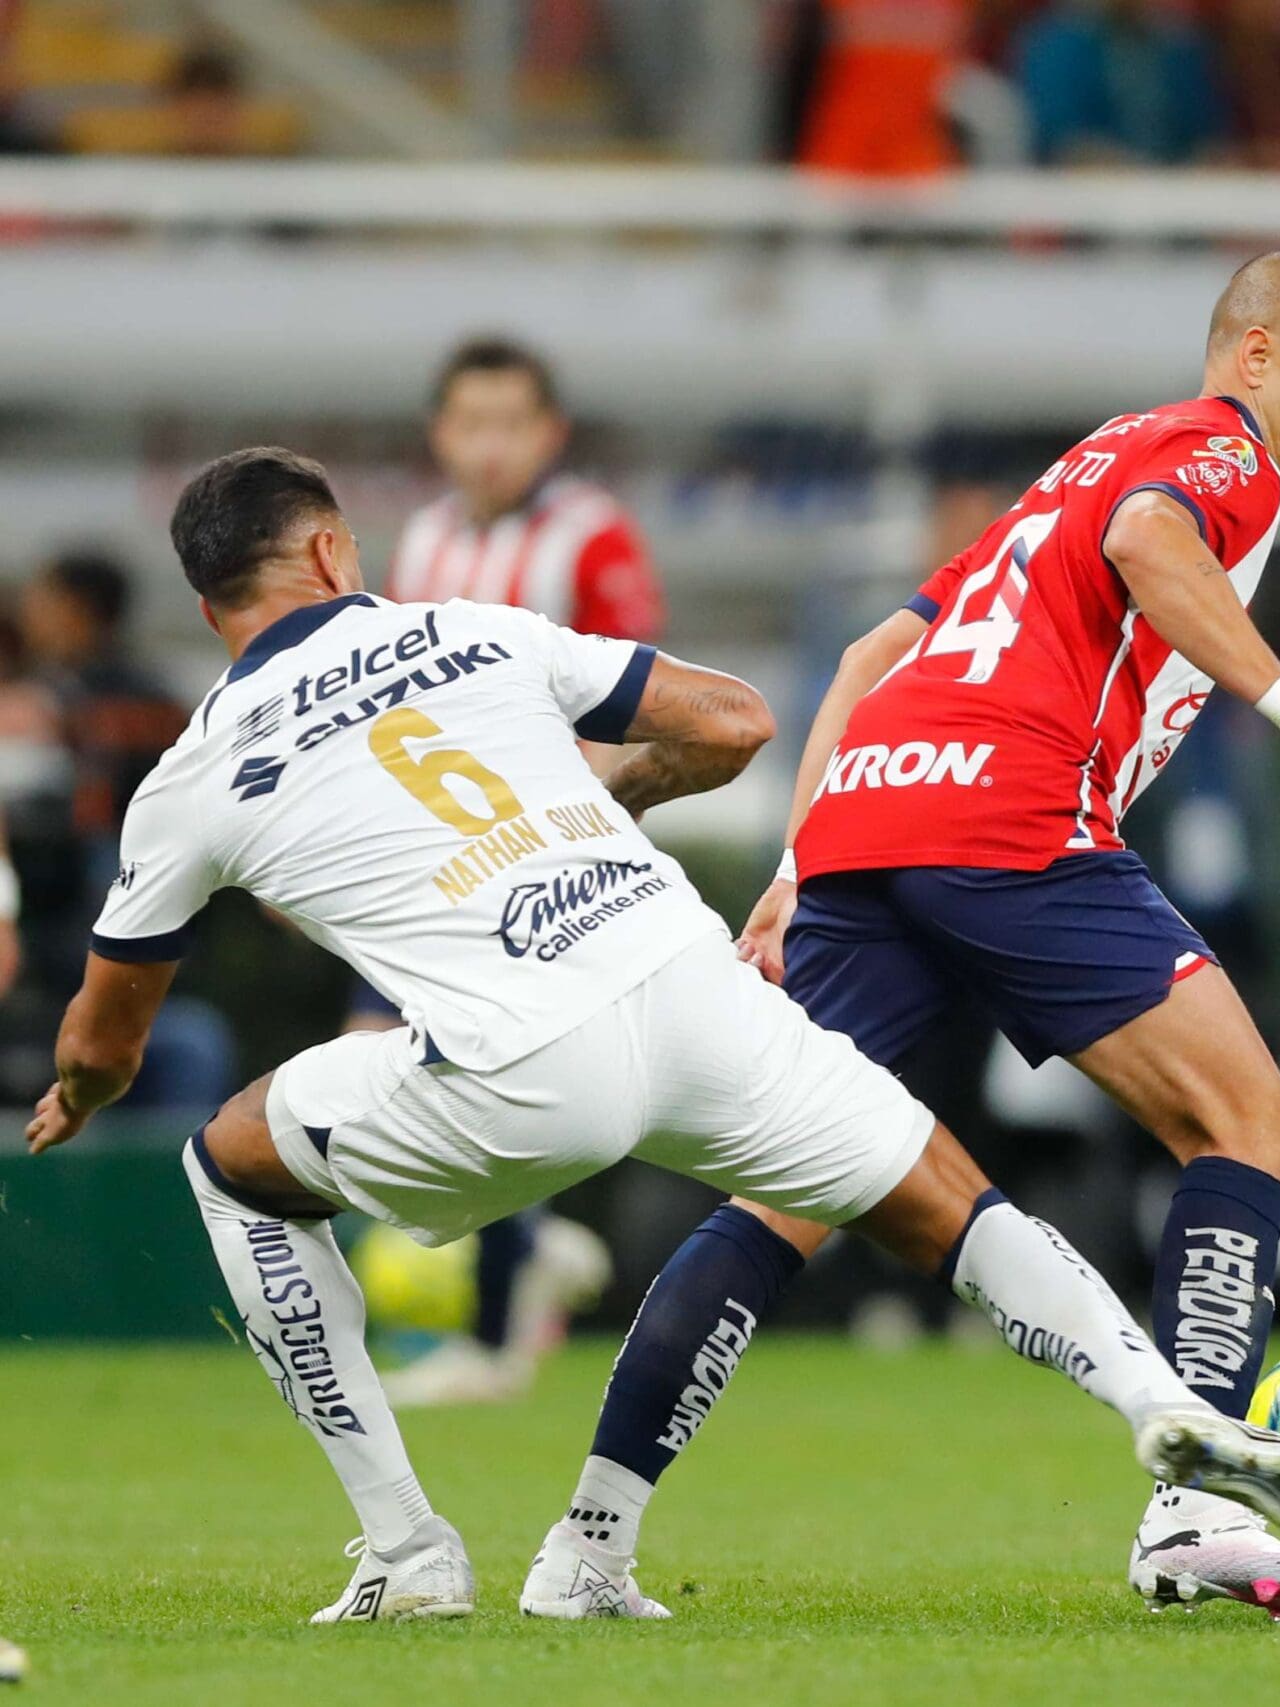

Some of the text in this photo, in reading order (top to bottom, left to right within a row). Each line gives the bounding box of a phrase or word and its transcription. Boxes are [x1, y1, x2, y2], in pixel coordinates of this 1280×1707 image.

[291, 610, 441, 717] telcel
[294, 641, 514, 752] SUZUKI
[368, 706, 526, 838] 6
[431, 801, 622, 906] NATHAN SILVA
[535, 874, 674, 963] caliente.mx
[1174, 1226, 1260, 1391] PERDURA
